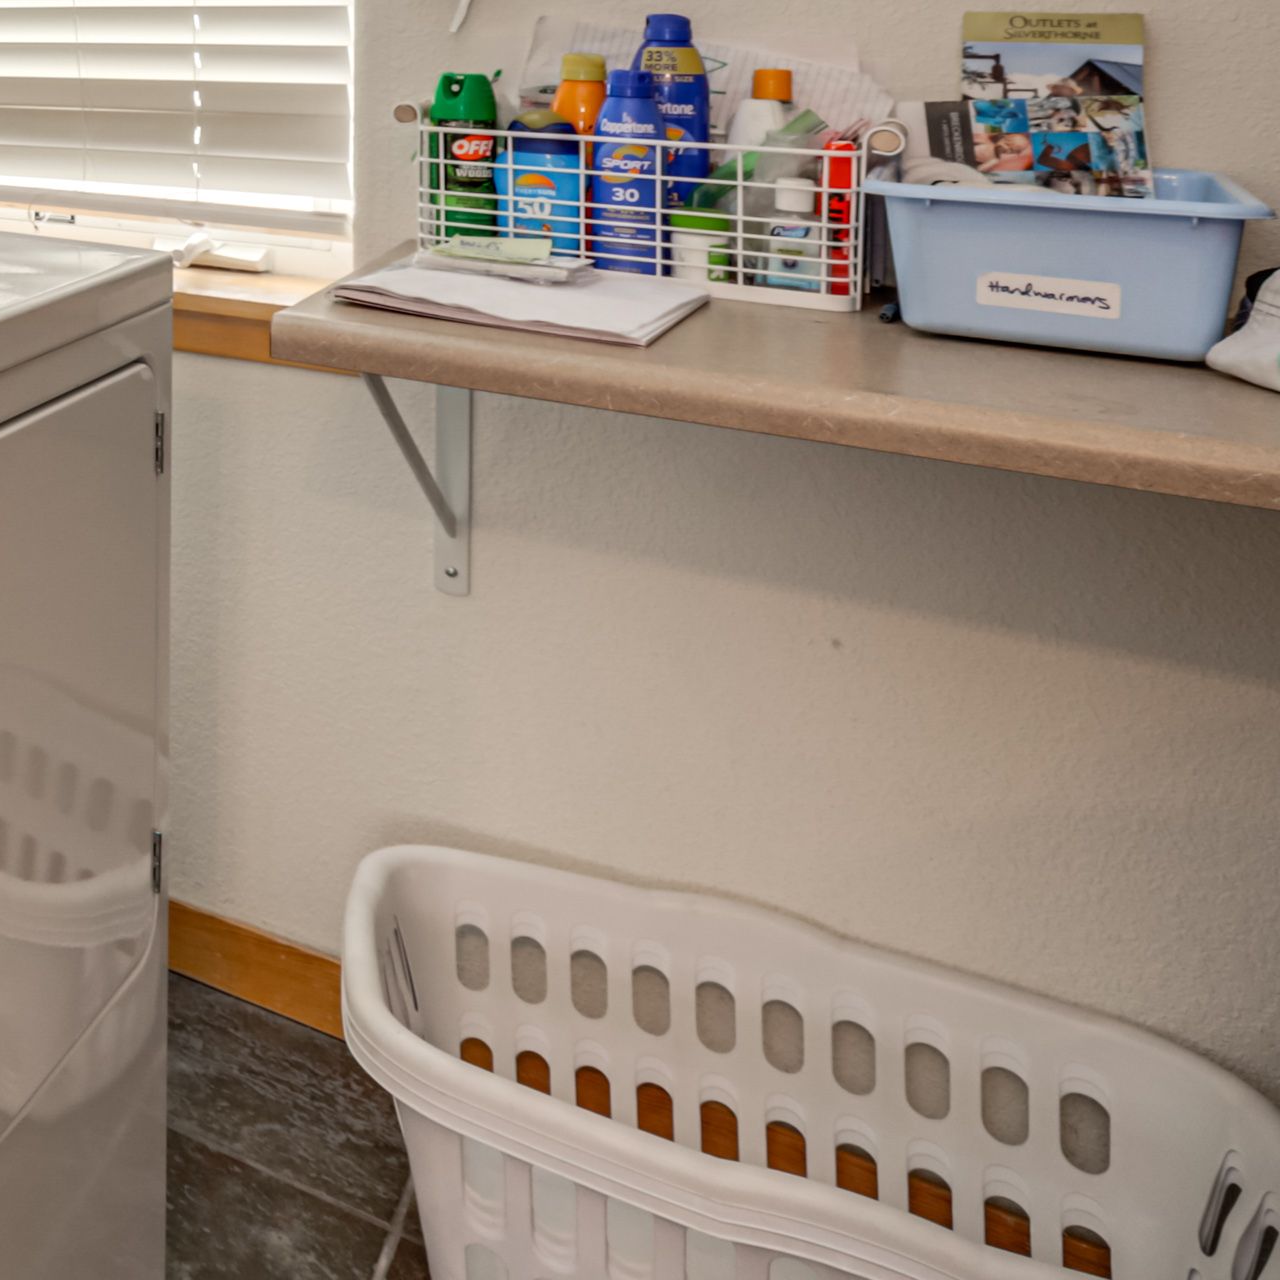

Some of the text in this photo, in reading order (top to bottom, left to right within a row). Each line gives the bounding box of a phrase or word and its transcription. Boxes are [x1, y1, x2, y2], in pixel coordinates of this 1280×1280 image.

[646, 50, 678, 63] 33%
[644, 63, 678, 71] MORE
[451, 138, 494, 157] OFF!
[601, 157, 652, 171] SPORT
[611, 187, 640, 202] 30
[517, 196, 552, 219] 50
[987, 280, 1111, 310] Handwarmers
